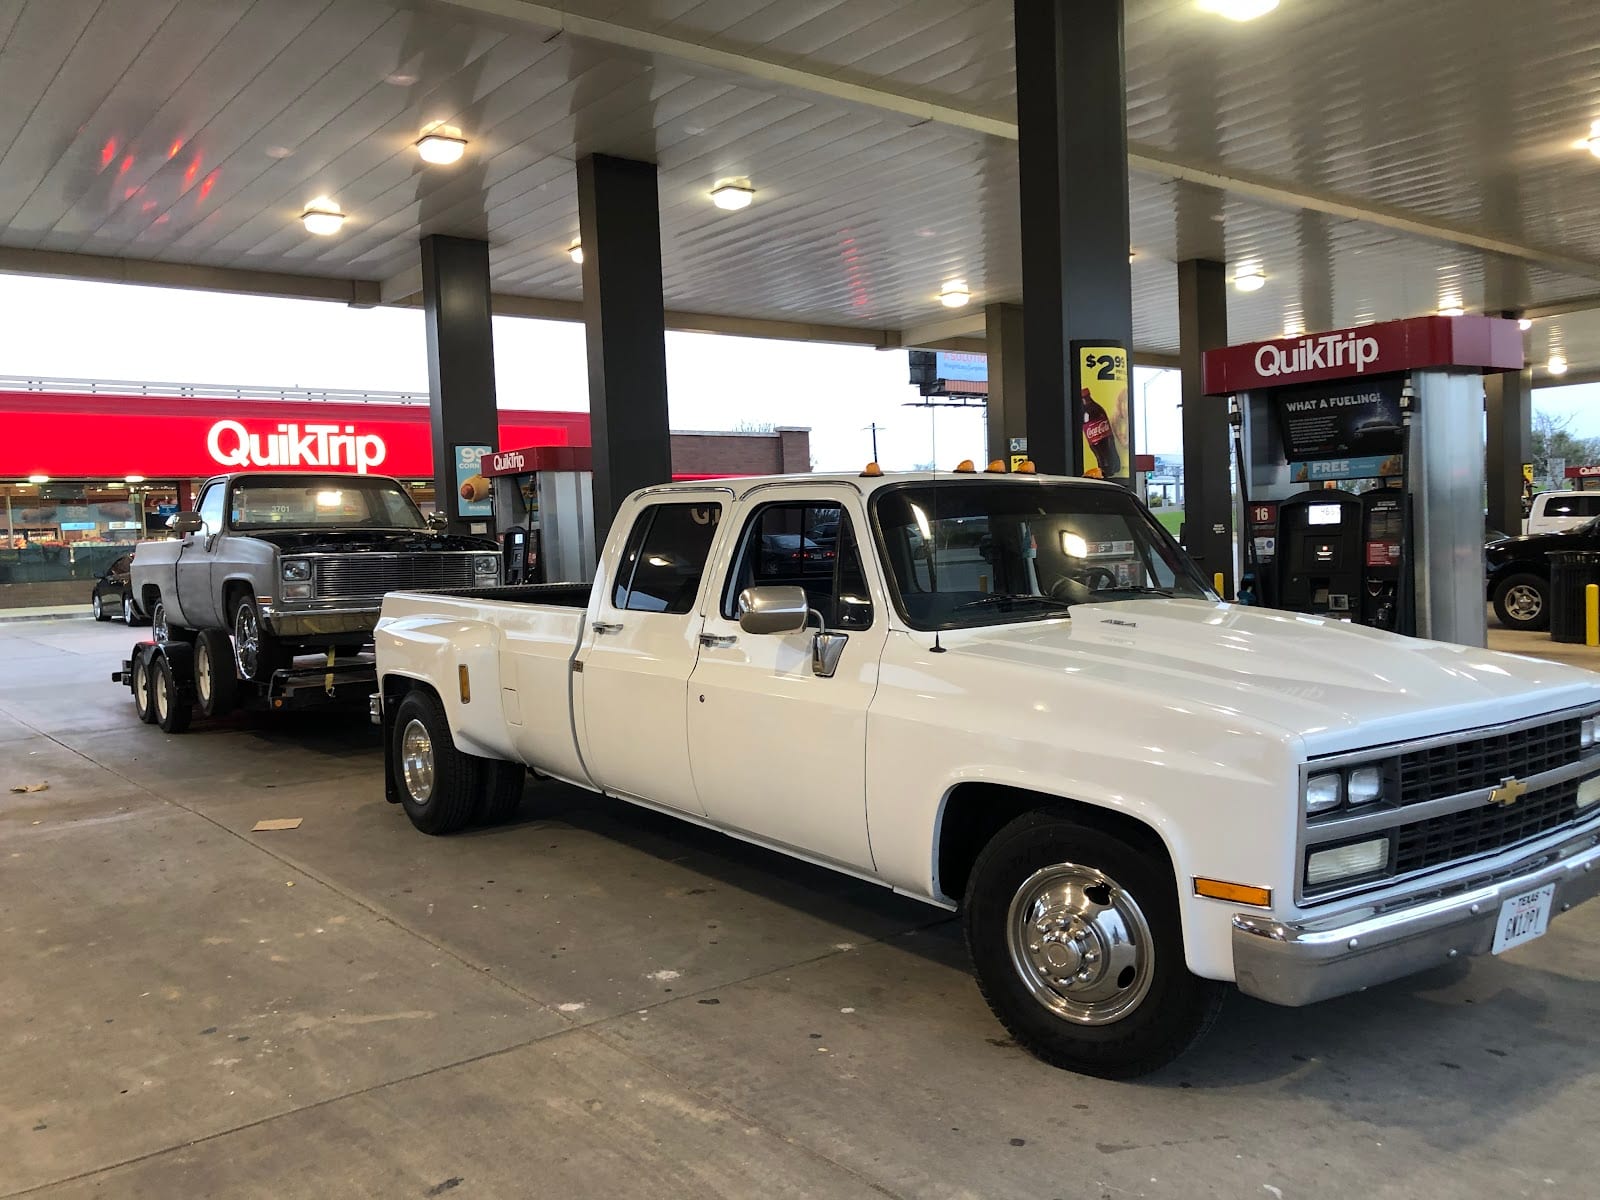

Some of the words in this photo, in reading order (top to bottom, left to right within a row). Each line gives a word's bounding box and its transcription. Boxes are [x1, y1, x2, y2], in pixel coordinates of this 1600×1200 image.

[1255, 332, 1379, 376] QuikTrip
[1286, 399, 1317, 412] WHAT
[1319, 400, 1328, 409] A
[1329, 392, 1381, 408] FUELING!
[207, 419, 386, 473] QuikTrip
[493, 452, 525, 472] QuikTrip
[1312, 460, 1350, 474] FREE
[271, 505, 290, 513] 3701
[1254, 507, 1269, 521] 16
